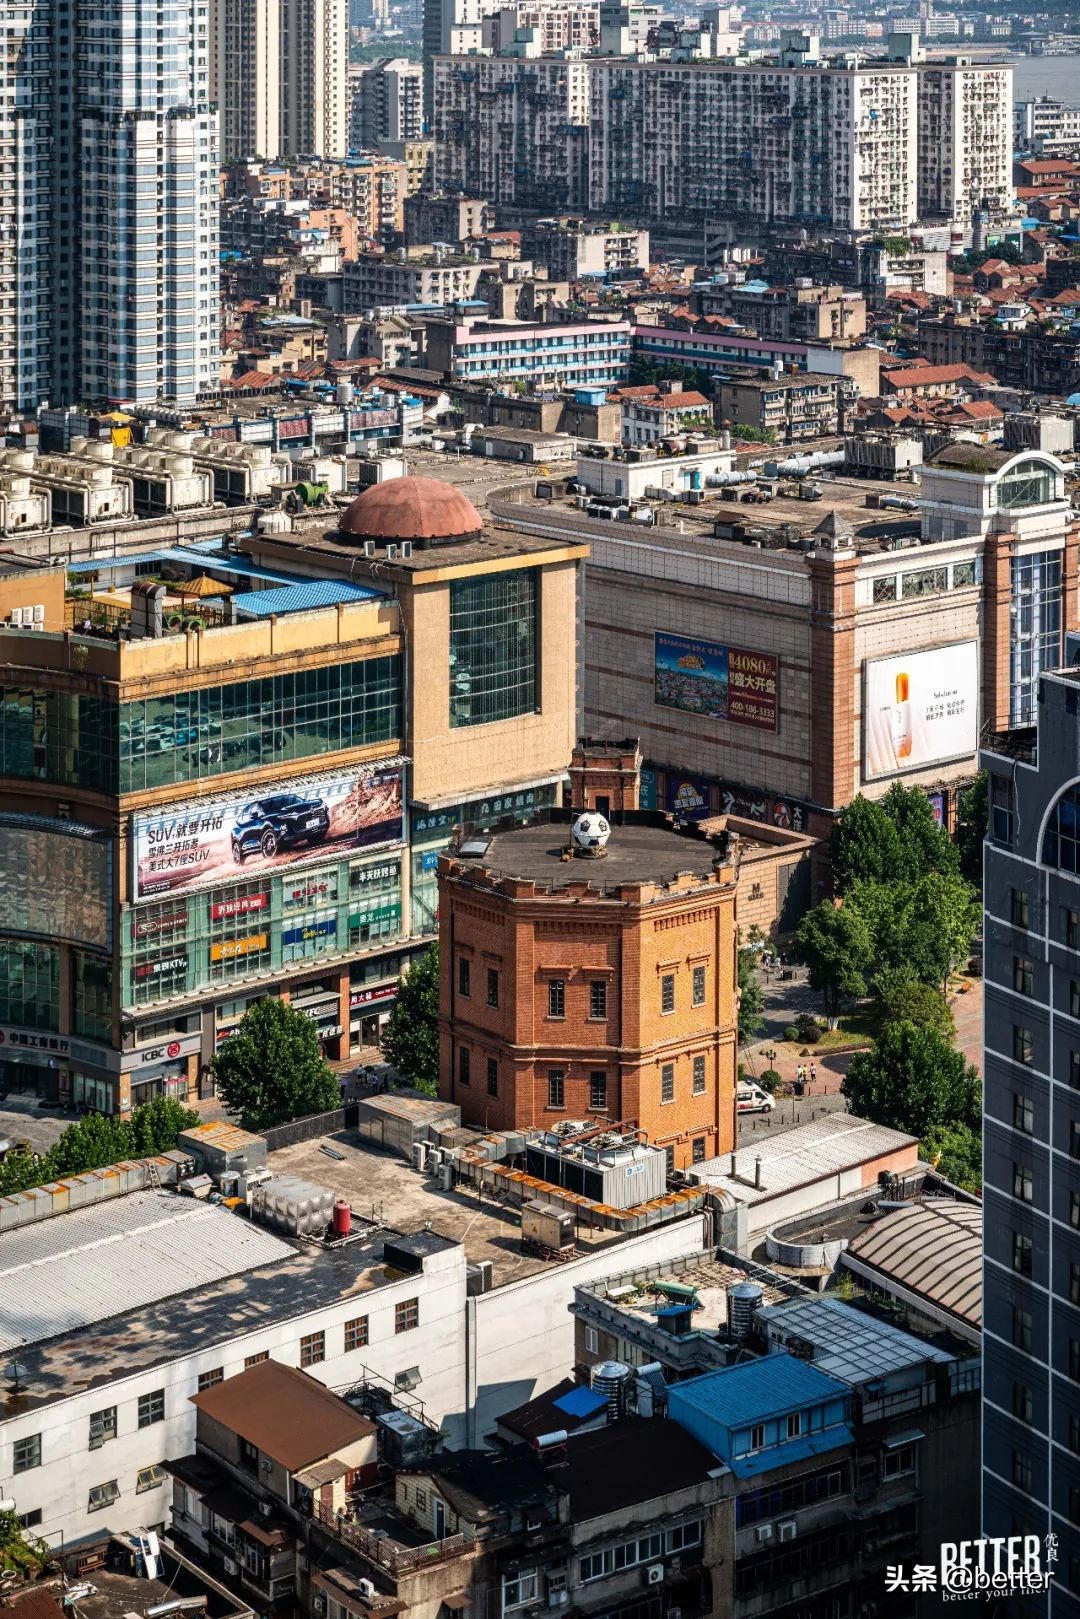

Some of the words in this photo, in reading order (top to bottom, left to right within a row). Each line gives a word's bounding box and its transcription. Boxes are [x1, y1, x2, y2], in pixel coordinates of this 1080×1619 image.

[734, 654, 766, 675] 4080
[735, 672, 776, 694] 盛大开盘
[351, 992, 372, 1004] 周大福
[10, 1032, 70, 1051] 中国工商银行
[142, 1048, 165, 1062] ICBC
